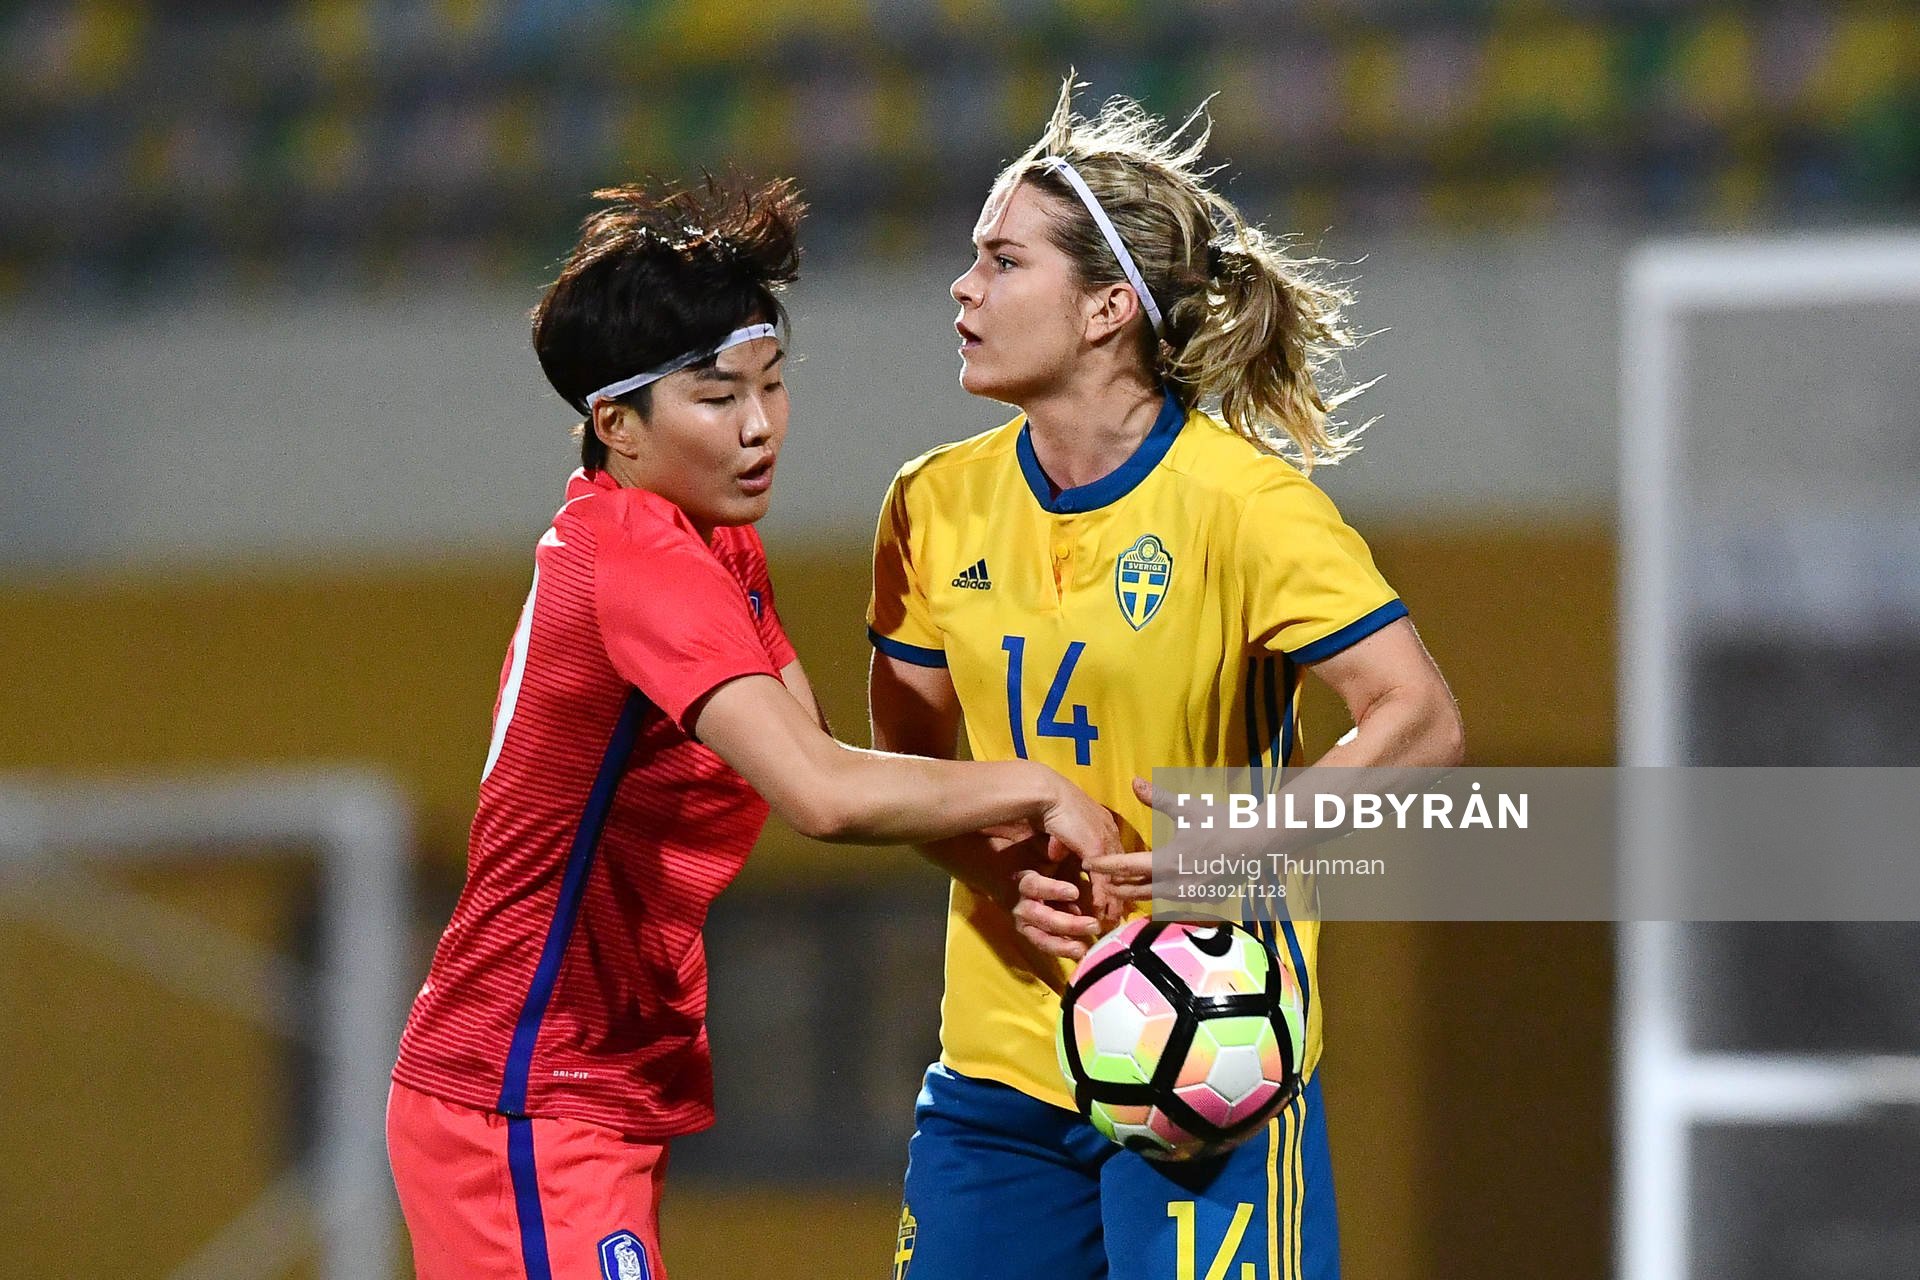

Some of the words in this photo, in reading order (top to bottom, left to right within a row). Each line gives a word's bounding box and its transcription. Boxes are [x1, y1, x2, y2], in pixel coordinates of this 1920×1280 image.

[951, 576, 992, 591] adidas
[1128, 561, 1163, 572] SVERIGE
[1001, 635, 1099, 766] 14
[1167, 1200, 1256, 1280] 14
